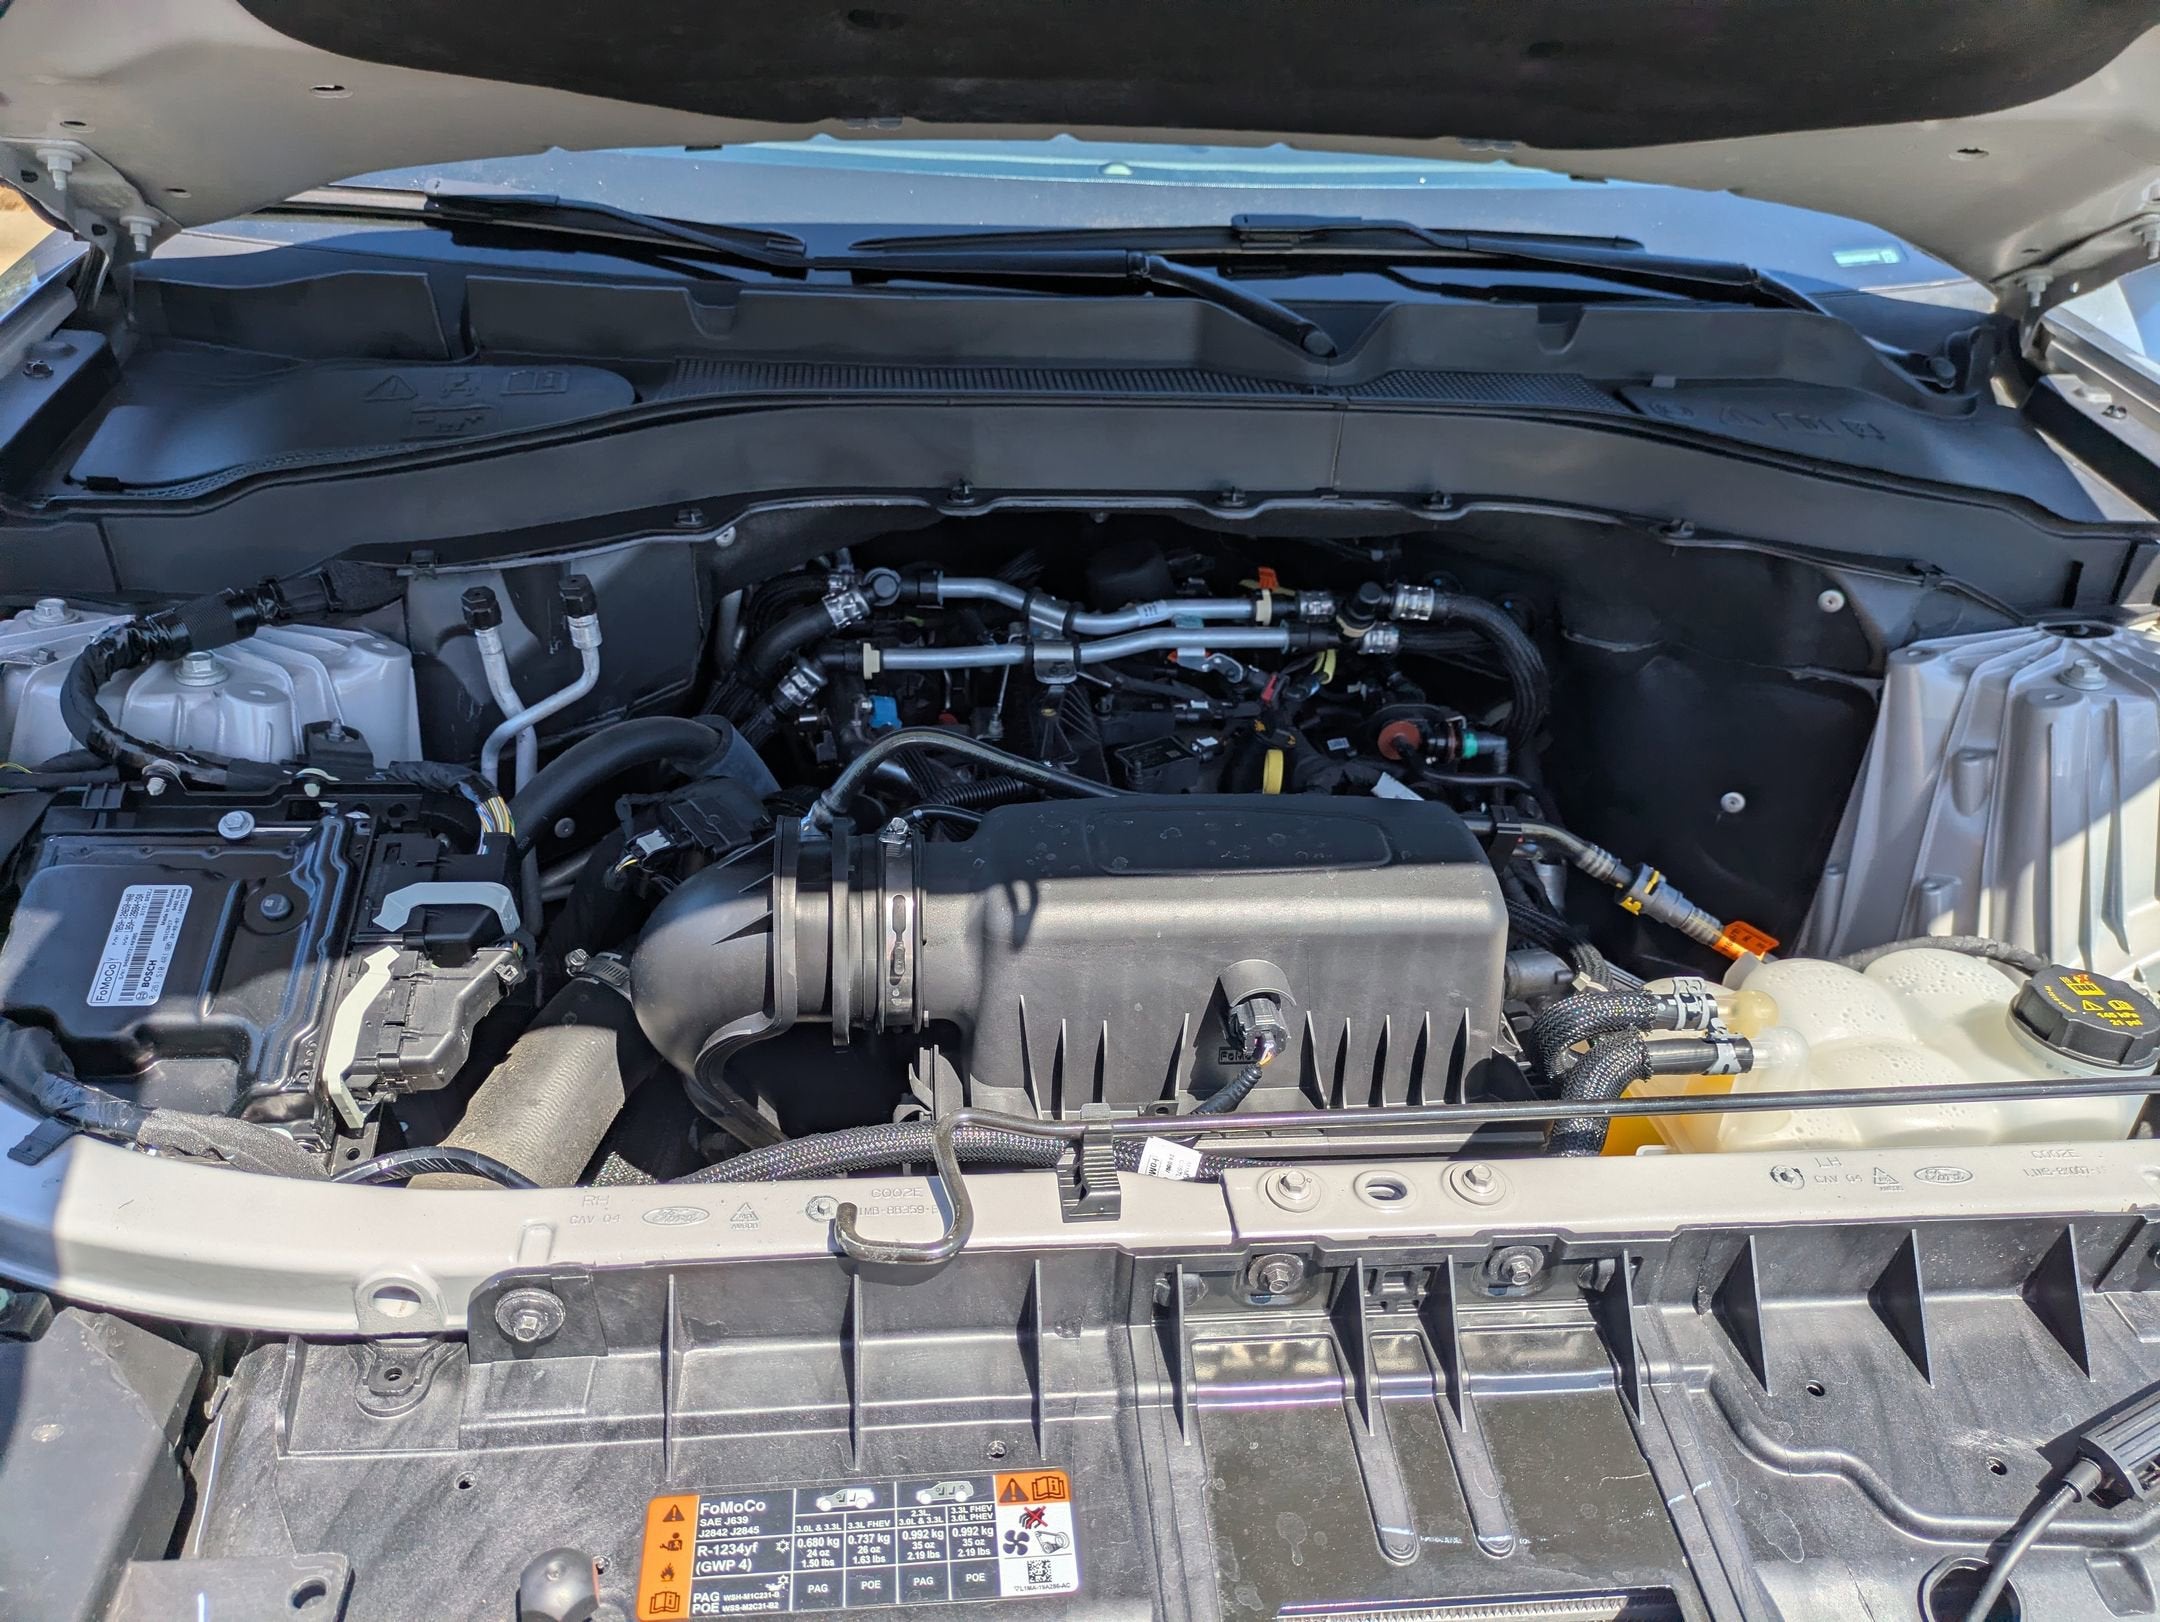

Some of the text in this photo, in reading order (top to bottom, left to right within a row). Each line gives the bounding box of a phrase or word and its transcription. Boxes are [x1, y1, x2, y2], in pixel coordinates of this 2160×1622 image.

[160, 913, 169, 926] Made
[167, 888, 177, 908] Romania
[141, 959, 157, 988] BOSCH
[96, 964, 117, 1001] FoMoCo
[582, 1194, 610, 1207] RH
[650, 1207, 701, 1225] Ford
[700, 1500, 766, 1515] FoMoCo
[951, 1504, 993, 1514] 3.3L FHEV
[700, 1516, 749, 1527] SAE J639
[899, 1518, 918, 1526] 3.0L
[928, 1516, 944, 1524] 3.3L
[951, 1512, 993, 1522] 3.0L PHEV
[796, 1525, 814, 1533] 3.0L
[824, 1523, 842, 1531] 3.3L
[848, 1519, 891, 1530] 3.3L FHEV
[698, 1526, 760, 1538] J2842 J2845
[902, 1529, 944, 1540] 0.992 kg
[952, 1526, 994, 1538] 0.992 kg
[797, 1536, 840, 1548] 0.680 kg
[848, 1533, 891, 1544] 0.737 kg
[962, 1538, 974, 1547] 35
[697, 1542, 759, 1557] R-1234yf
[857, 1546, 869, 1554] 26
[912, 1541, 923, 1549] 35
[807, 1550, 818, 1558] 24
[907, 1550, 940, 1561] 2.19 lbs
[957, 1547, 991, 1558] 2.19 lbs
[801, 1558, 835, 1568] 1.50 lbs
[852, 1555, 886, 1565] 1.63 lbs
[695, 1558, 752, 1575] (GWP 4)
[913, 1577, 934, 1586] PAG
[965, 1573, 986, 1583] POE
[808, 1584, 828, 1593] PAG
[861, 1580, 881, 1590] POE
[693, 1592, 720, 1603] PAG
[692, 1603, 719, 1614] POE
